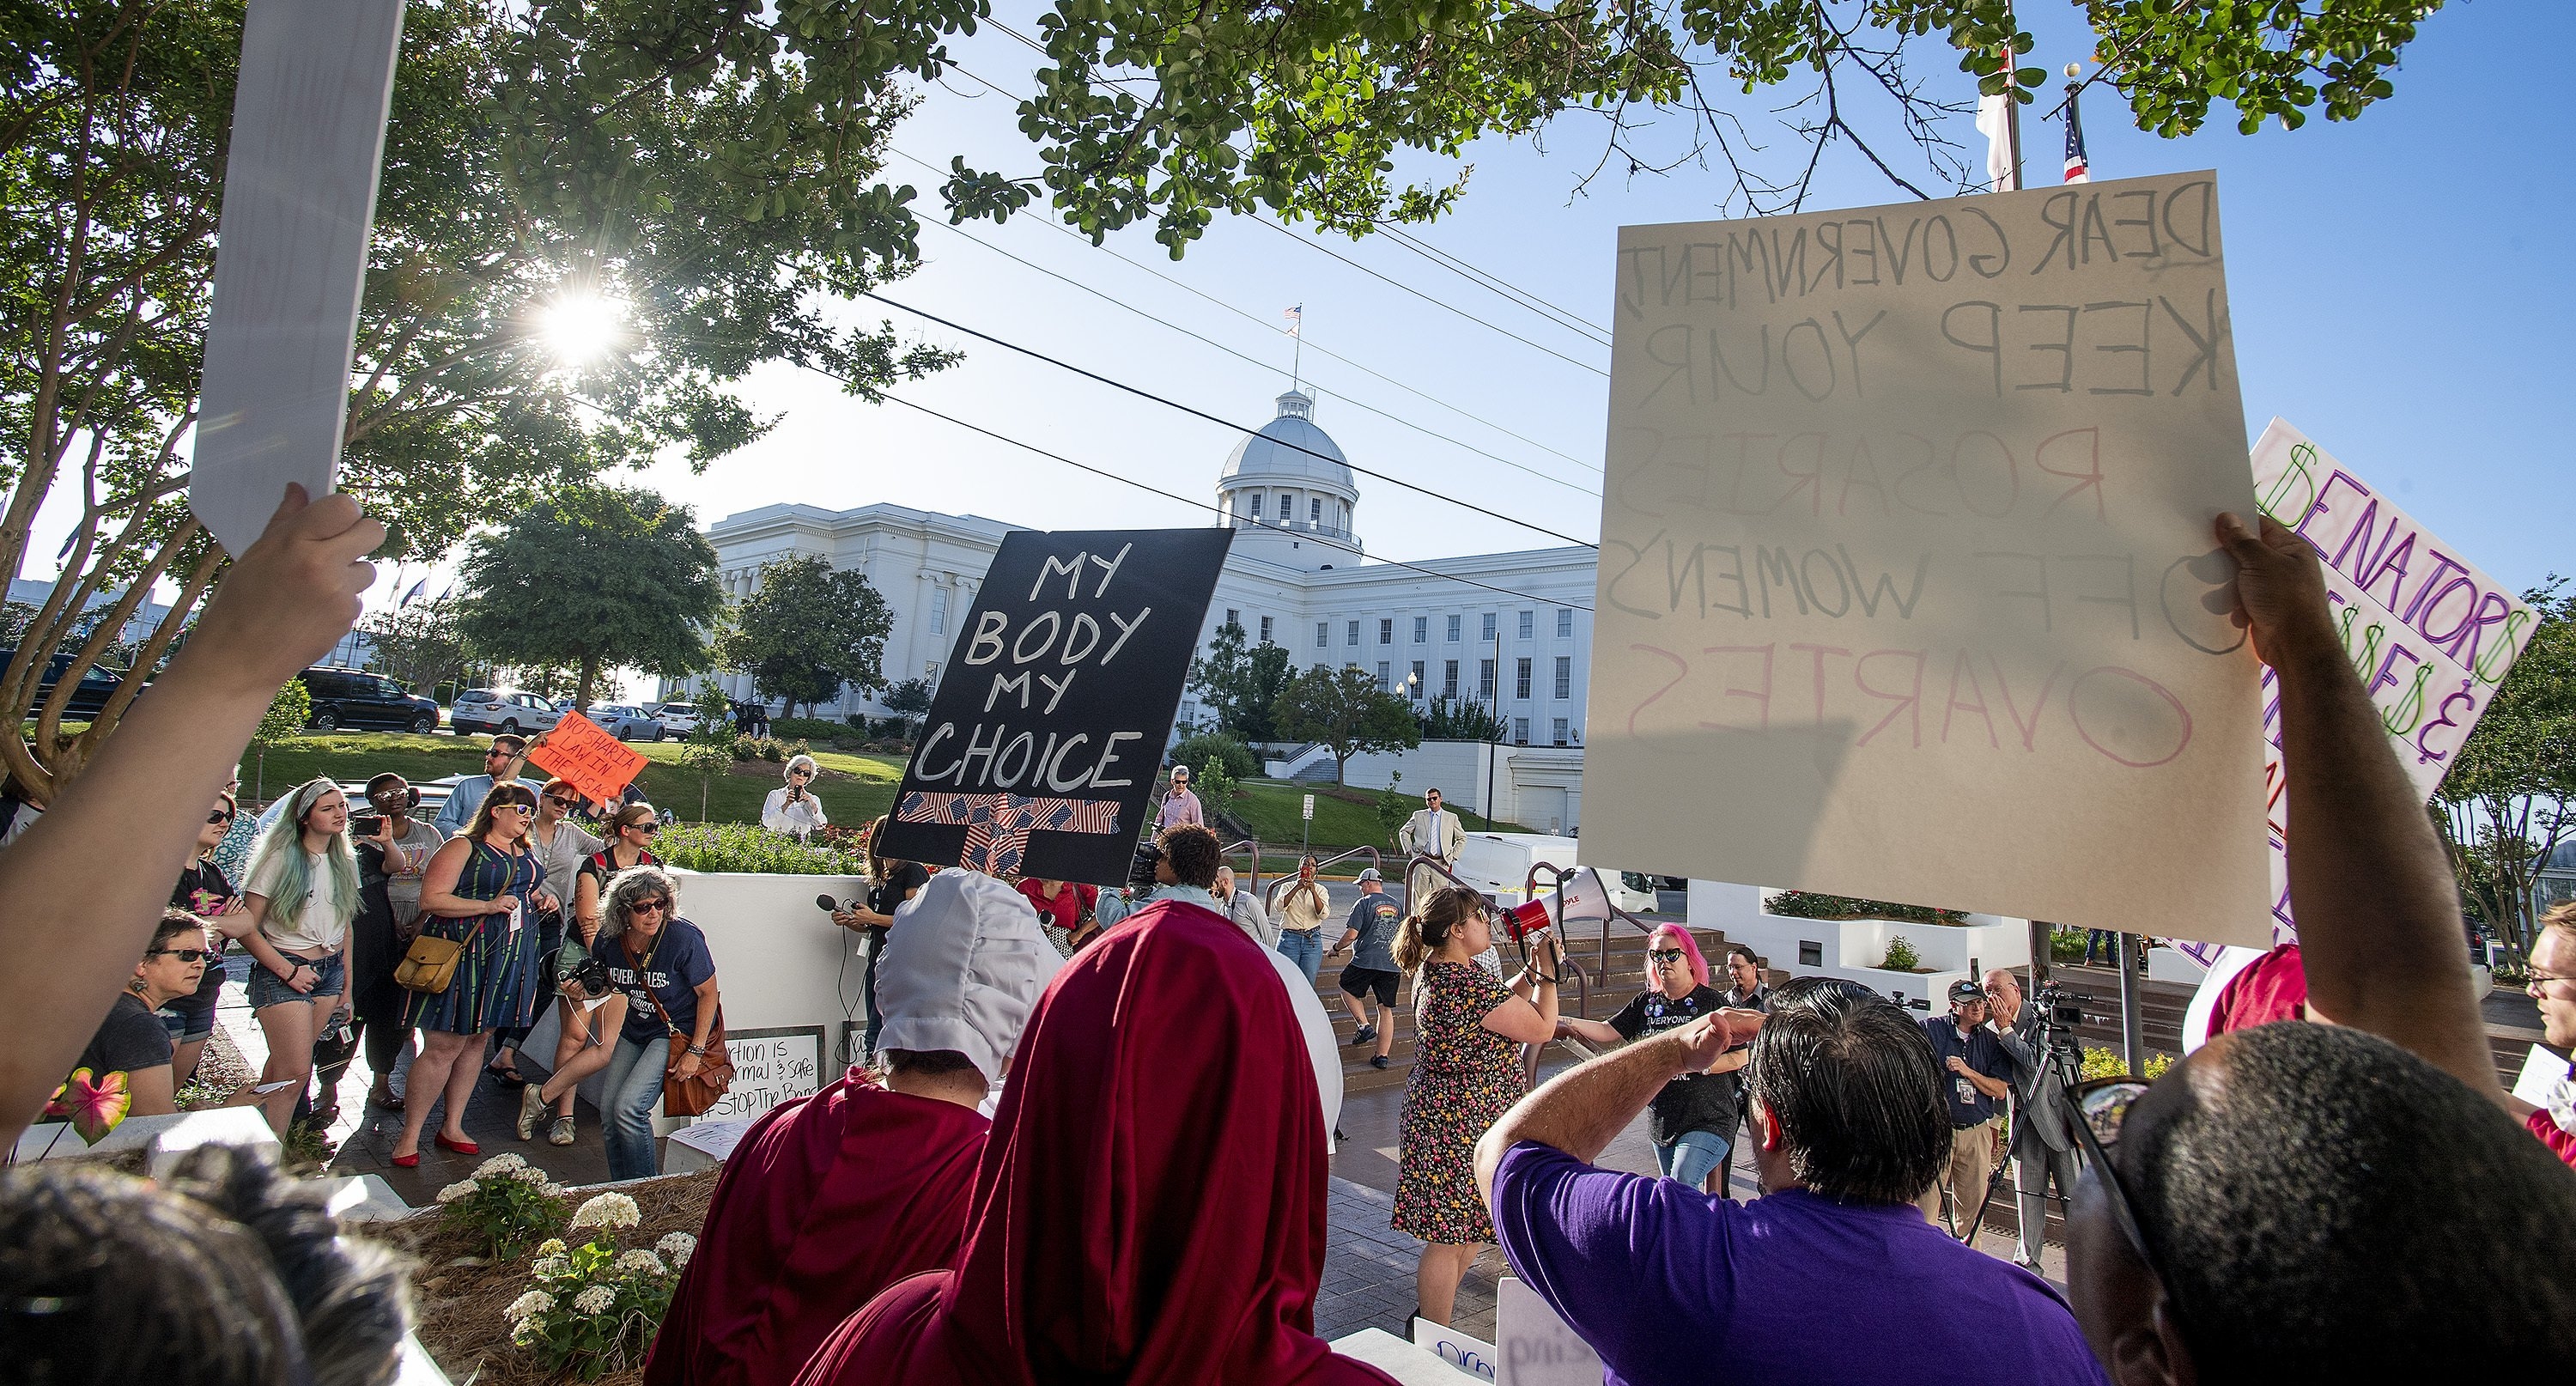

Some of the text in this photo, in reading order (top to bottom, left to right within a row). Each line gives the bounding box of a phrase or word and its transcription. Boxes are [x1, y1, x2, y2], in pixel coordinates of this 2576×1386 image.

[1029, 543, 1133, 602] MY
[964, 606, 1151, 667] BODY
[983, 668, 1078, 714] MY
[542, 747, 574, 775] THE
[558, 735, 612, 776] LAW IN
[562, 715, 636, 771] NO SHARIA
[914, 721, 1143, 793] CHOICE
[1647, 1015, 1692, 1026] EVERYONE
